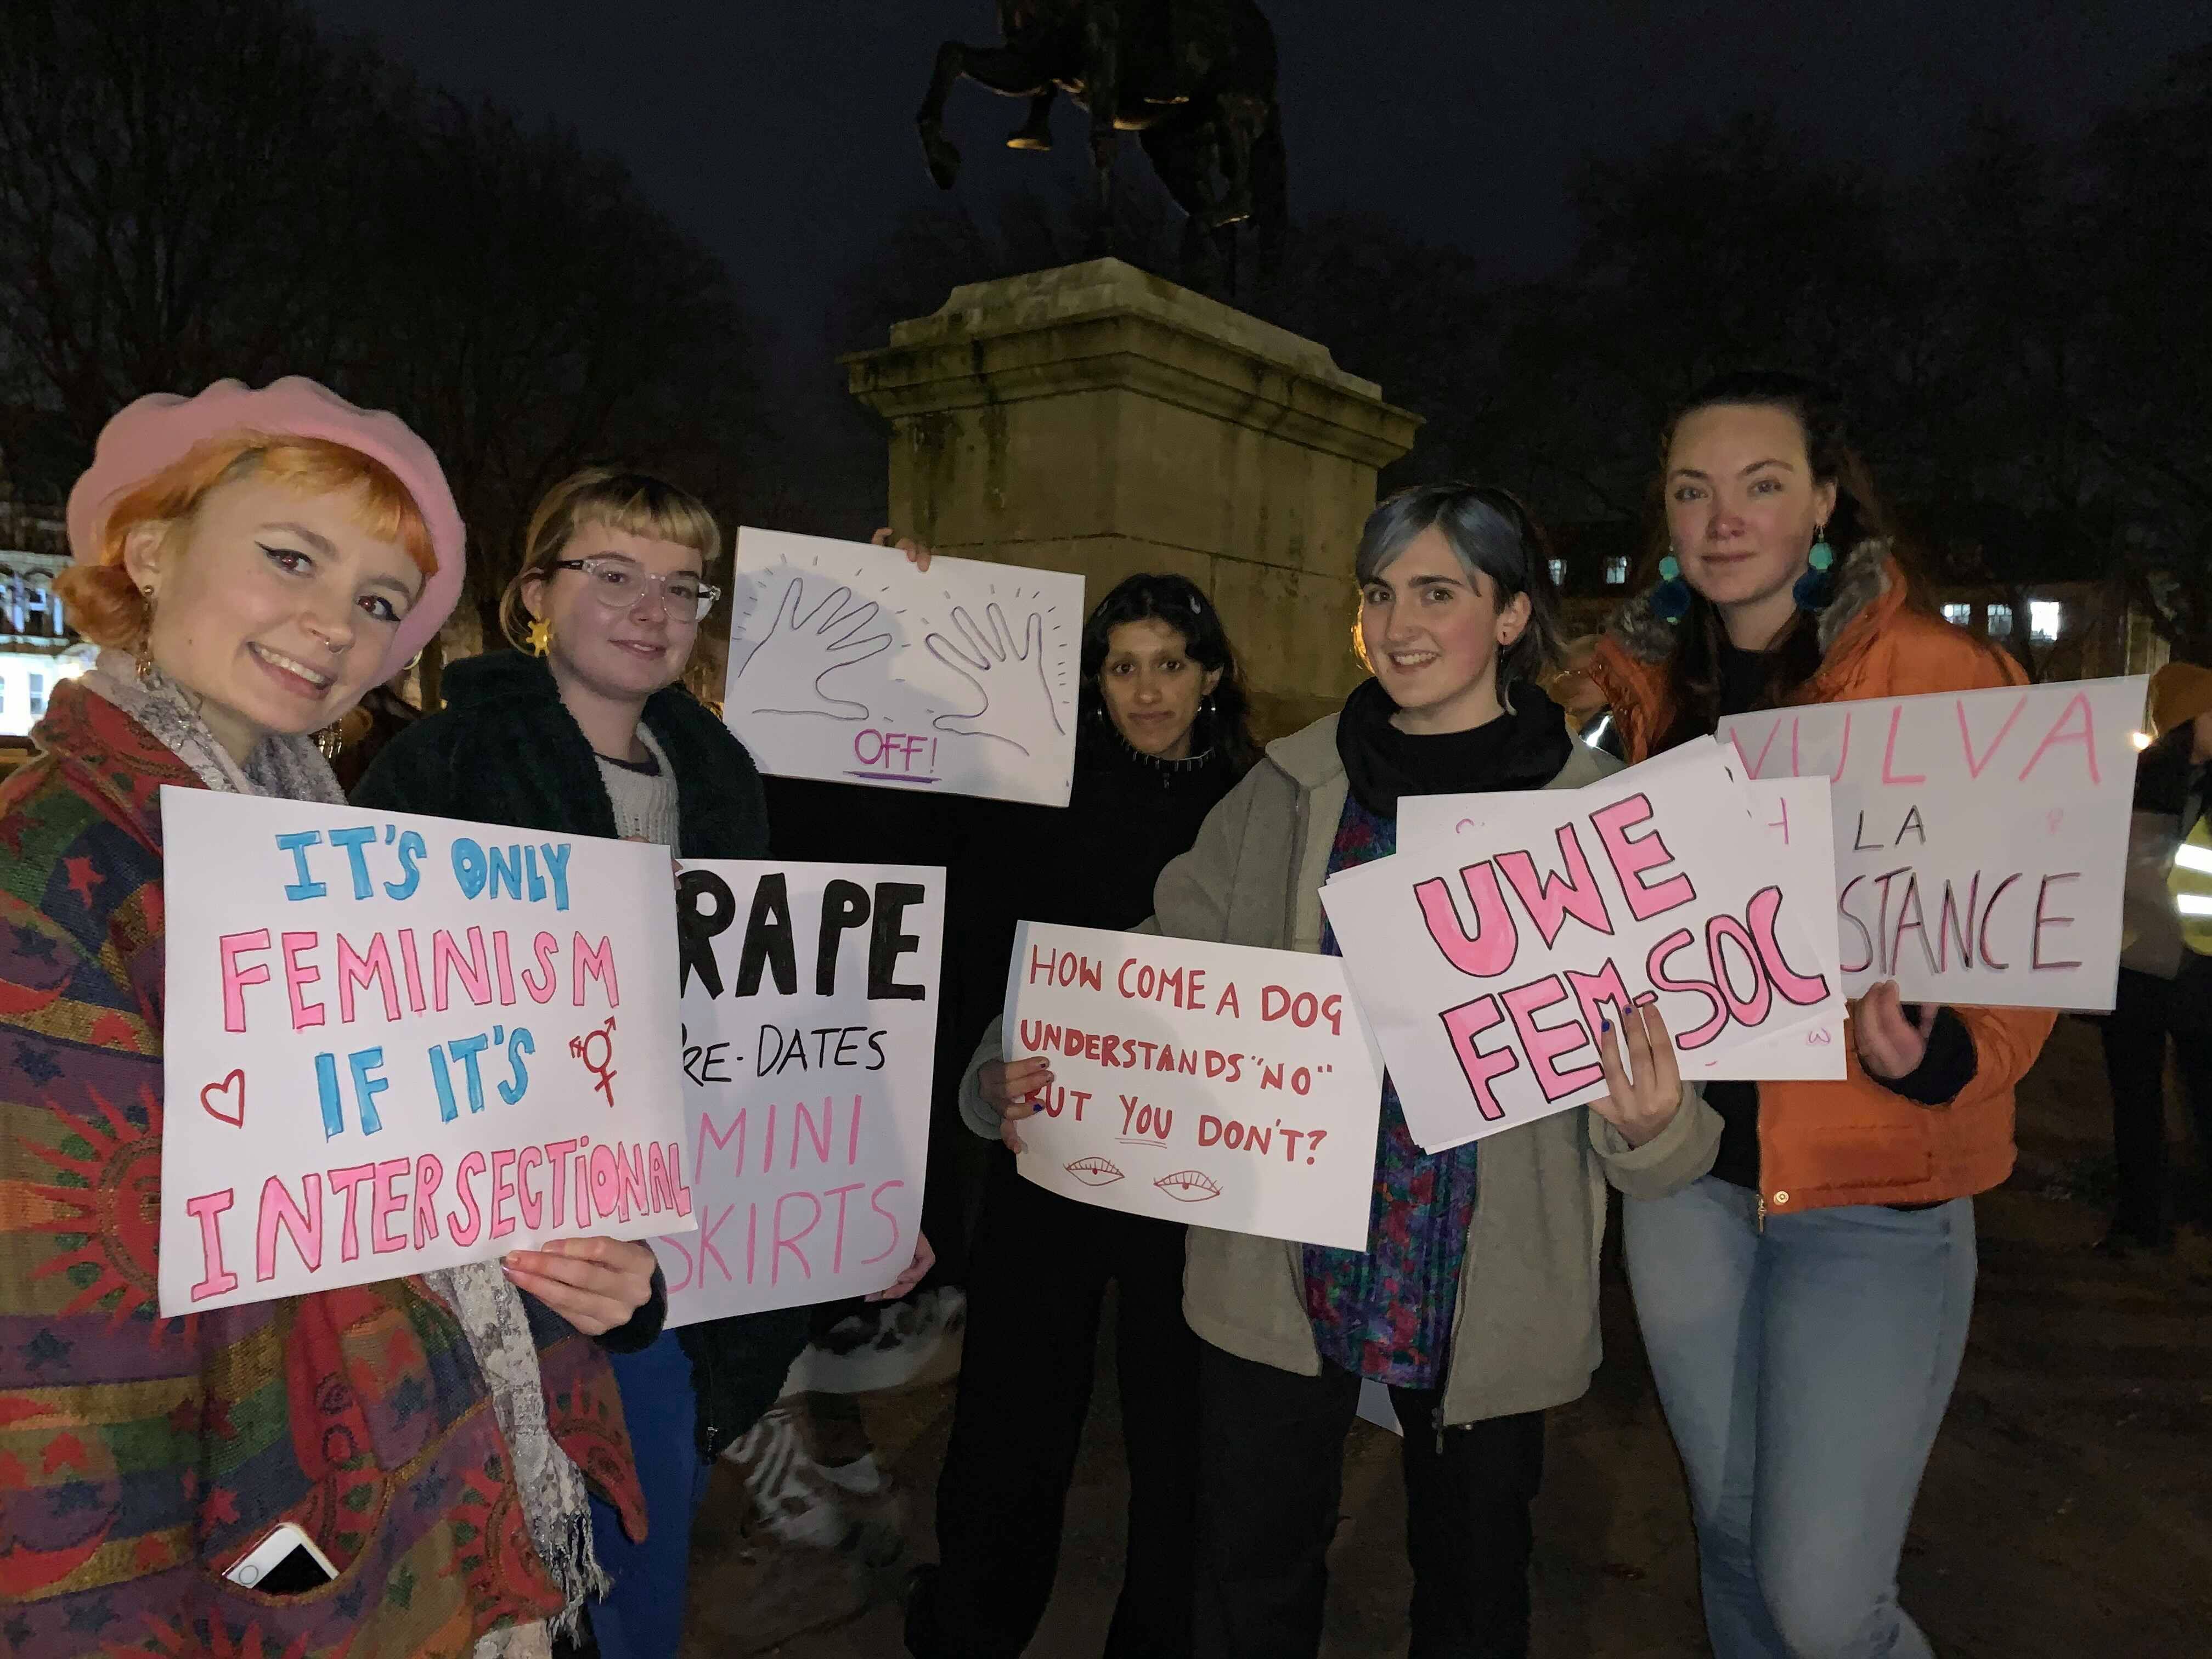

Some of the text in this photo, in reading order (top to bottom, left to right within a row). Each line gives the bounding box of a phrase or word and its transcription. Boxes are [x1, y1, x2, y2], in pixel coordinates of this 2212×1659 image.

[854, 728, 938, 774] OFF!
[1730, 691, 2103, 785] VULVA
[275, 824, 571, 911] IT'S ONLY
[1854, 804, 1926, 850] LA
[1413, 792, 1696, 978] UWE
[219, 926, 620, 1034] FEMINISM
[675, 870, 926, 1001] RAPE
[1029, 944, 1342, 1036] HOW COME A DOG
[314, 1024, 535, 1143] IF IT'S
[681, 1022, 888, 1087] RE-DATES
[1020, 1019, 1245, 1083] UNDERSTANDS
[695, 1094, 862, 1185] MINI
[1119, 1094, 1173, 1139] YOU
[1198, 1115, 1328, 1165] DON'T?
